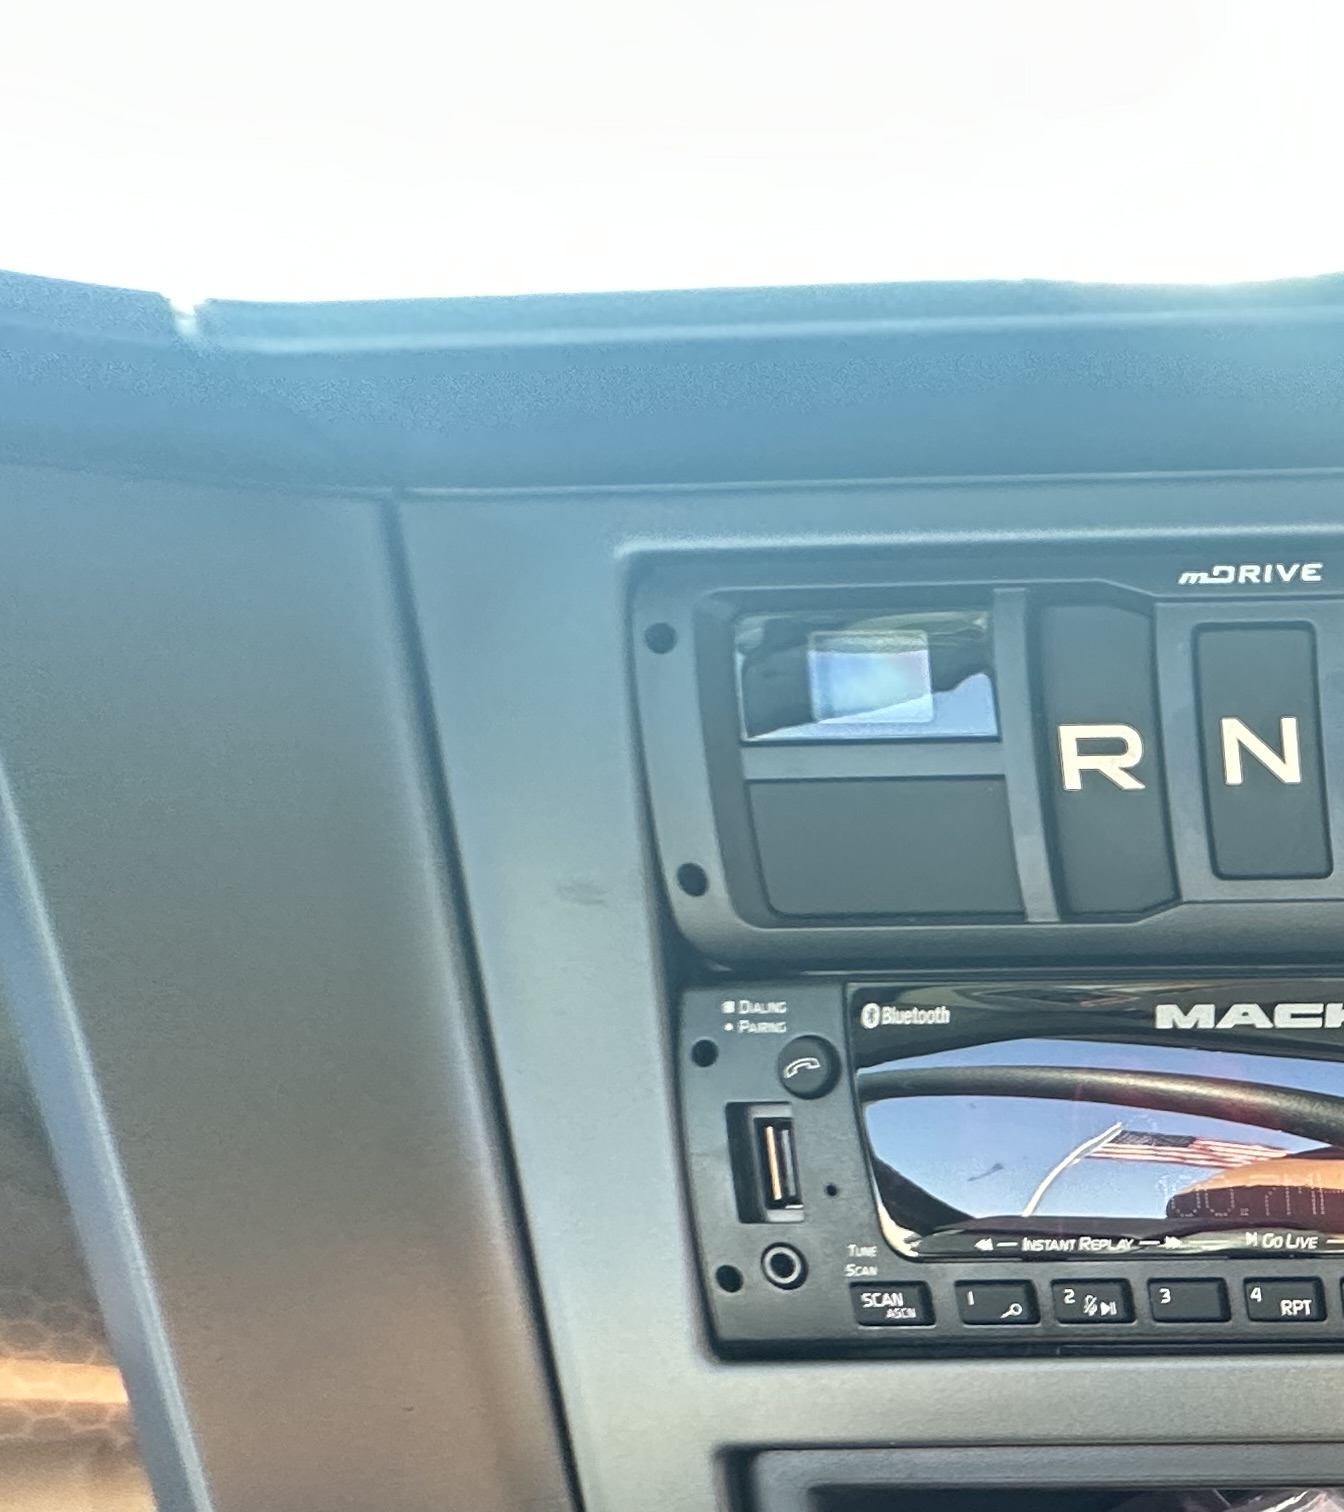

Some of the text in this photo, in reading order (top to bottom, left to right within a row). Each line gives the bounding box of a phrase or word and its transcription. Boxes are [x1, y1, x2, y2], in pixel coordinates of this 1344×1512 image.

[1058, 724, 1146, 791] R
[1220, 716, 1302, 787] N
[881, 1005, 950, 1025] Bluetooth
[861, 1292, 904, 1308] SCAN
[1063, 1289, 1075, 1304] 2
[1159, 1288, 1171, 1304] 3
[1249, 1287, 1263, 1302] 4
[1280, 1299, 1312, 1316] RPT
